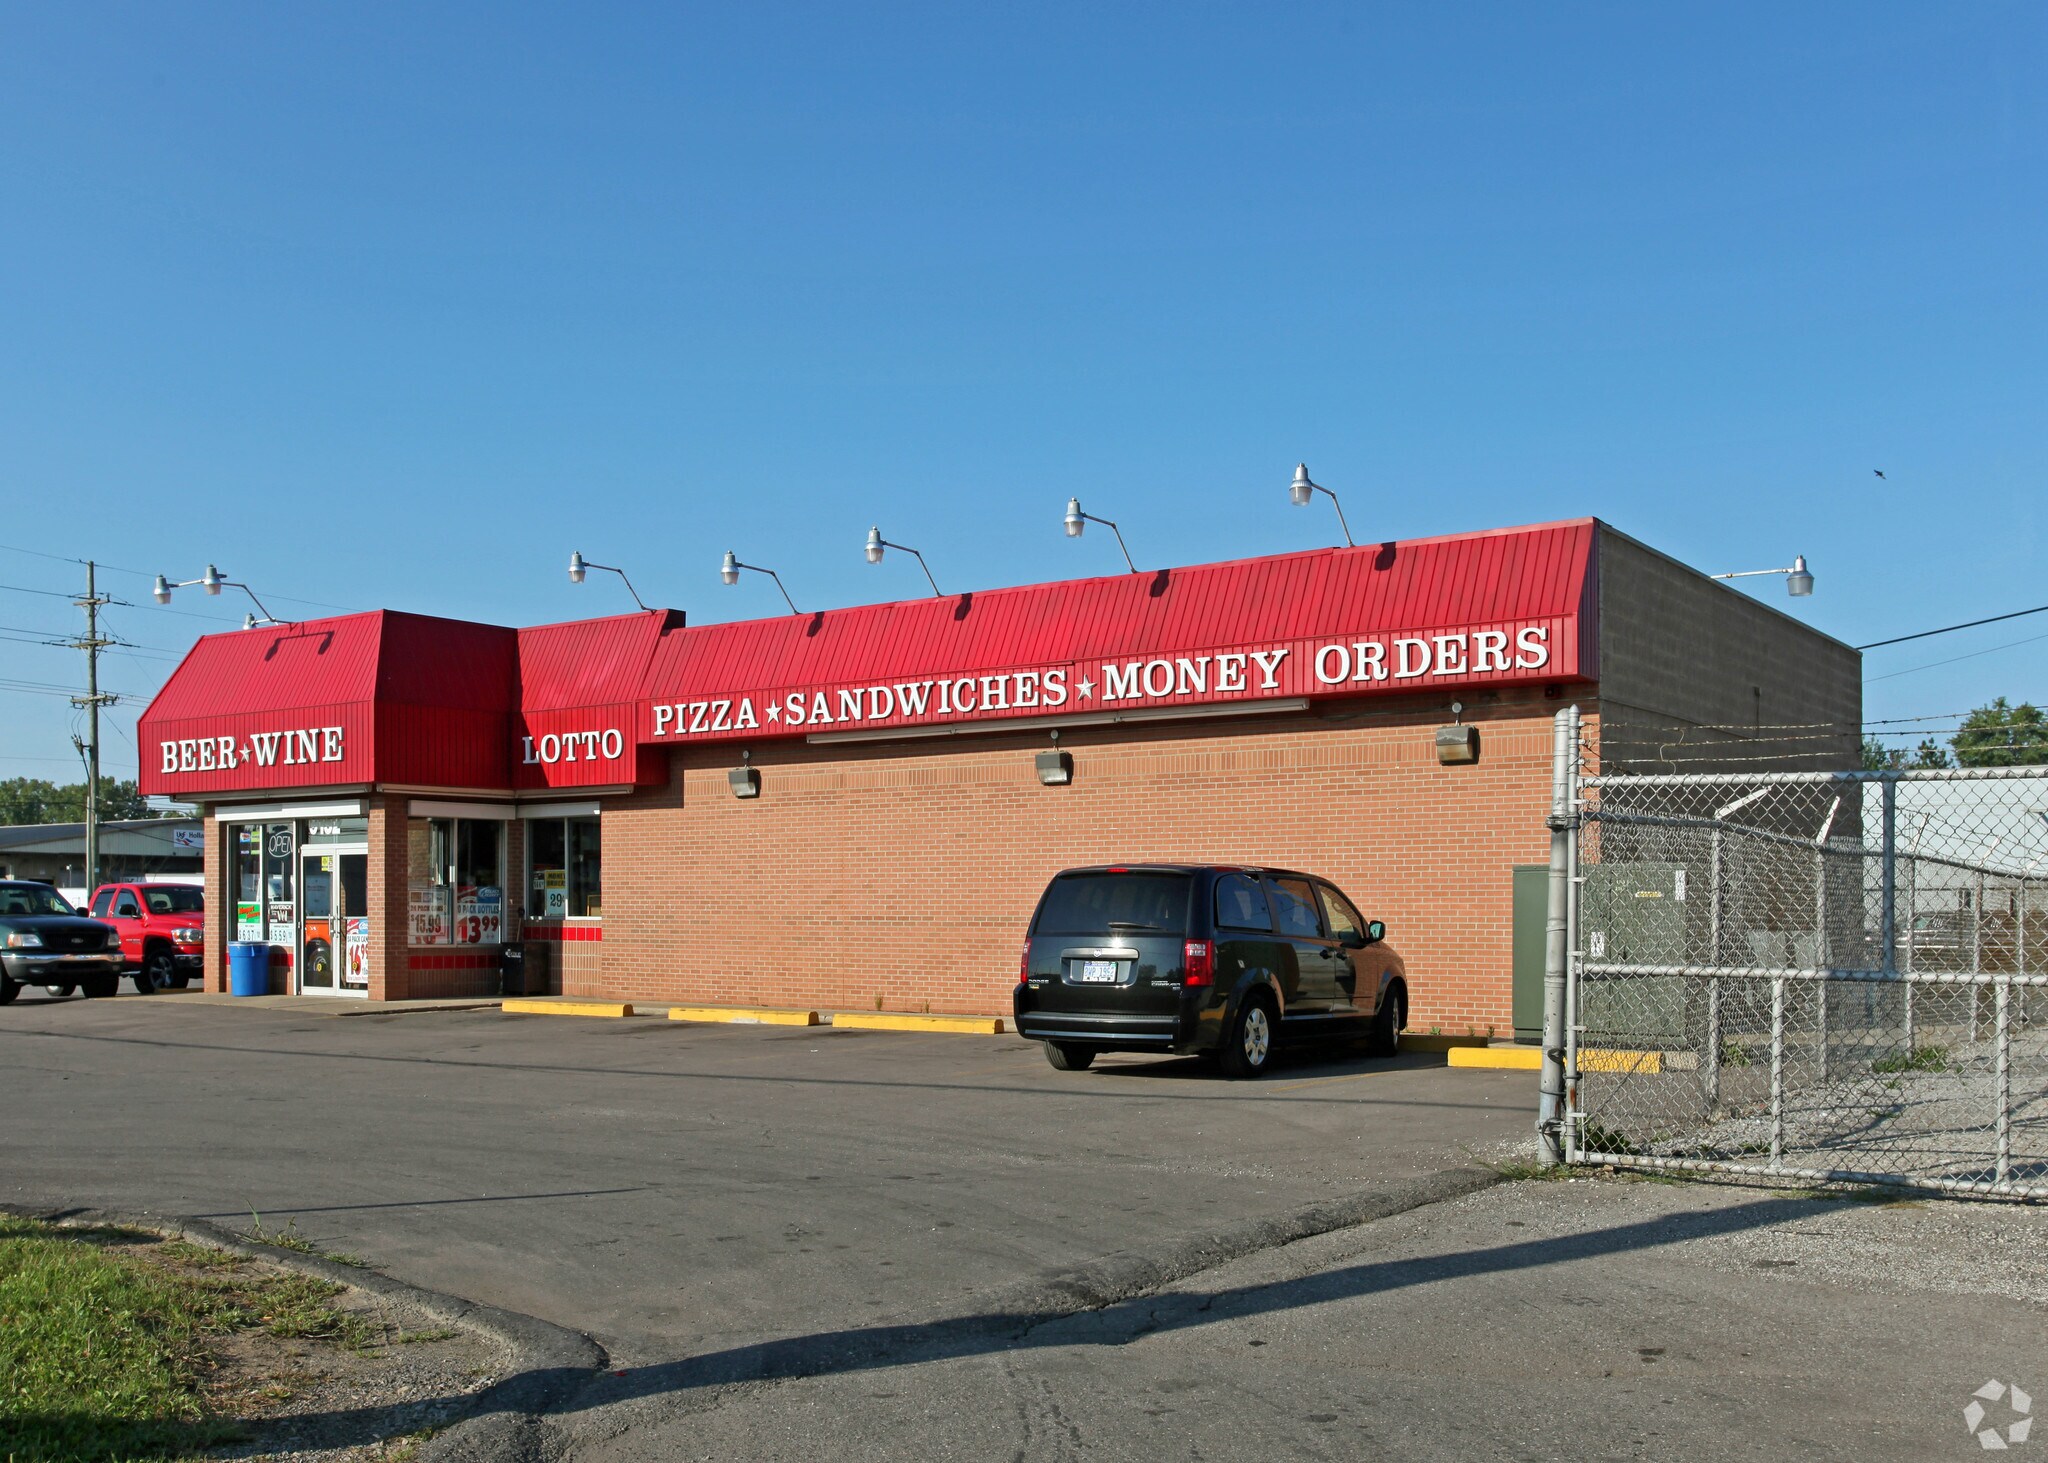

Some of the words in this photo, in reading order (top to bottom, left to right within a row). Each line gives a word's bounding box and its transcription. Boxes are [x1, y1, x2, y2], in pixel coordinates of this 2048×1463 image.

[653, 697, 759, 736] PIZZA
[785, 670, 1068, 726] SANDWICHES
[1102, 649, 1289, 702] MONEY
[1315, 626, 1549, 685] ORDERS
[160, 736, 237, 774] BEER
[250, 726, 344, 767] WINE
[522, 728, 624, 765] LOTTO
[268, 835, 293, 853] OPEN
